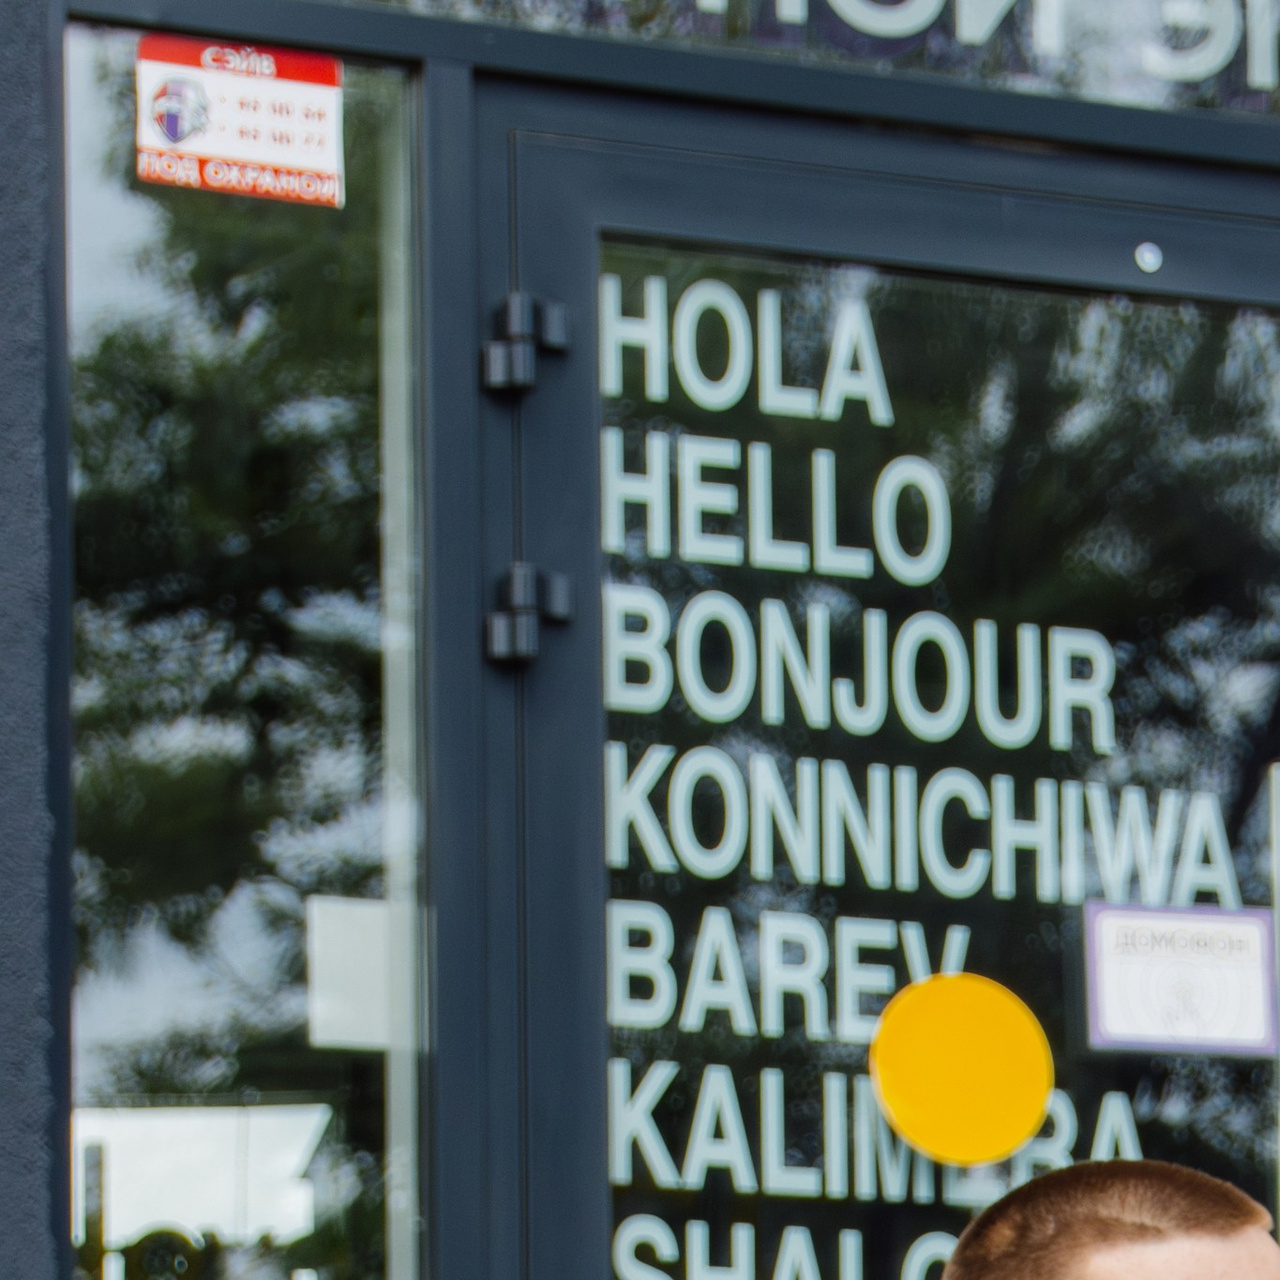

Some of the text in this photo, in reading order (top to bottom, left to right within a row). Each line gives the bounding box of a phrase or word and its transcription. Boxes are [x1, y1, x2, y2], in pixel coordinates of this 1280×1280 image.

[138, 150, 200, 188] ПОД
[600, 273, 894, 426] HOLA
[600, 427, 952, 587] HELLO
[602, 582, 1117, 755] BONJOUR
[603, 741, 1244, 911] KONNICHIWA
